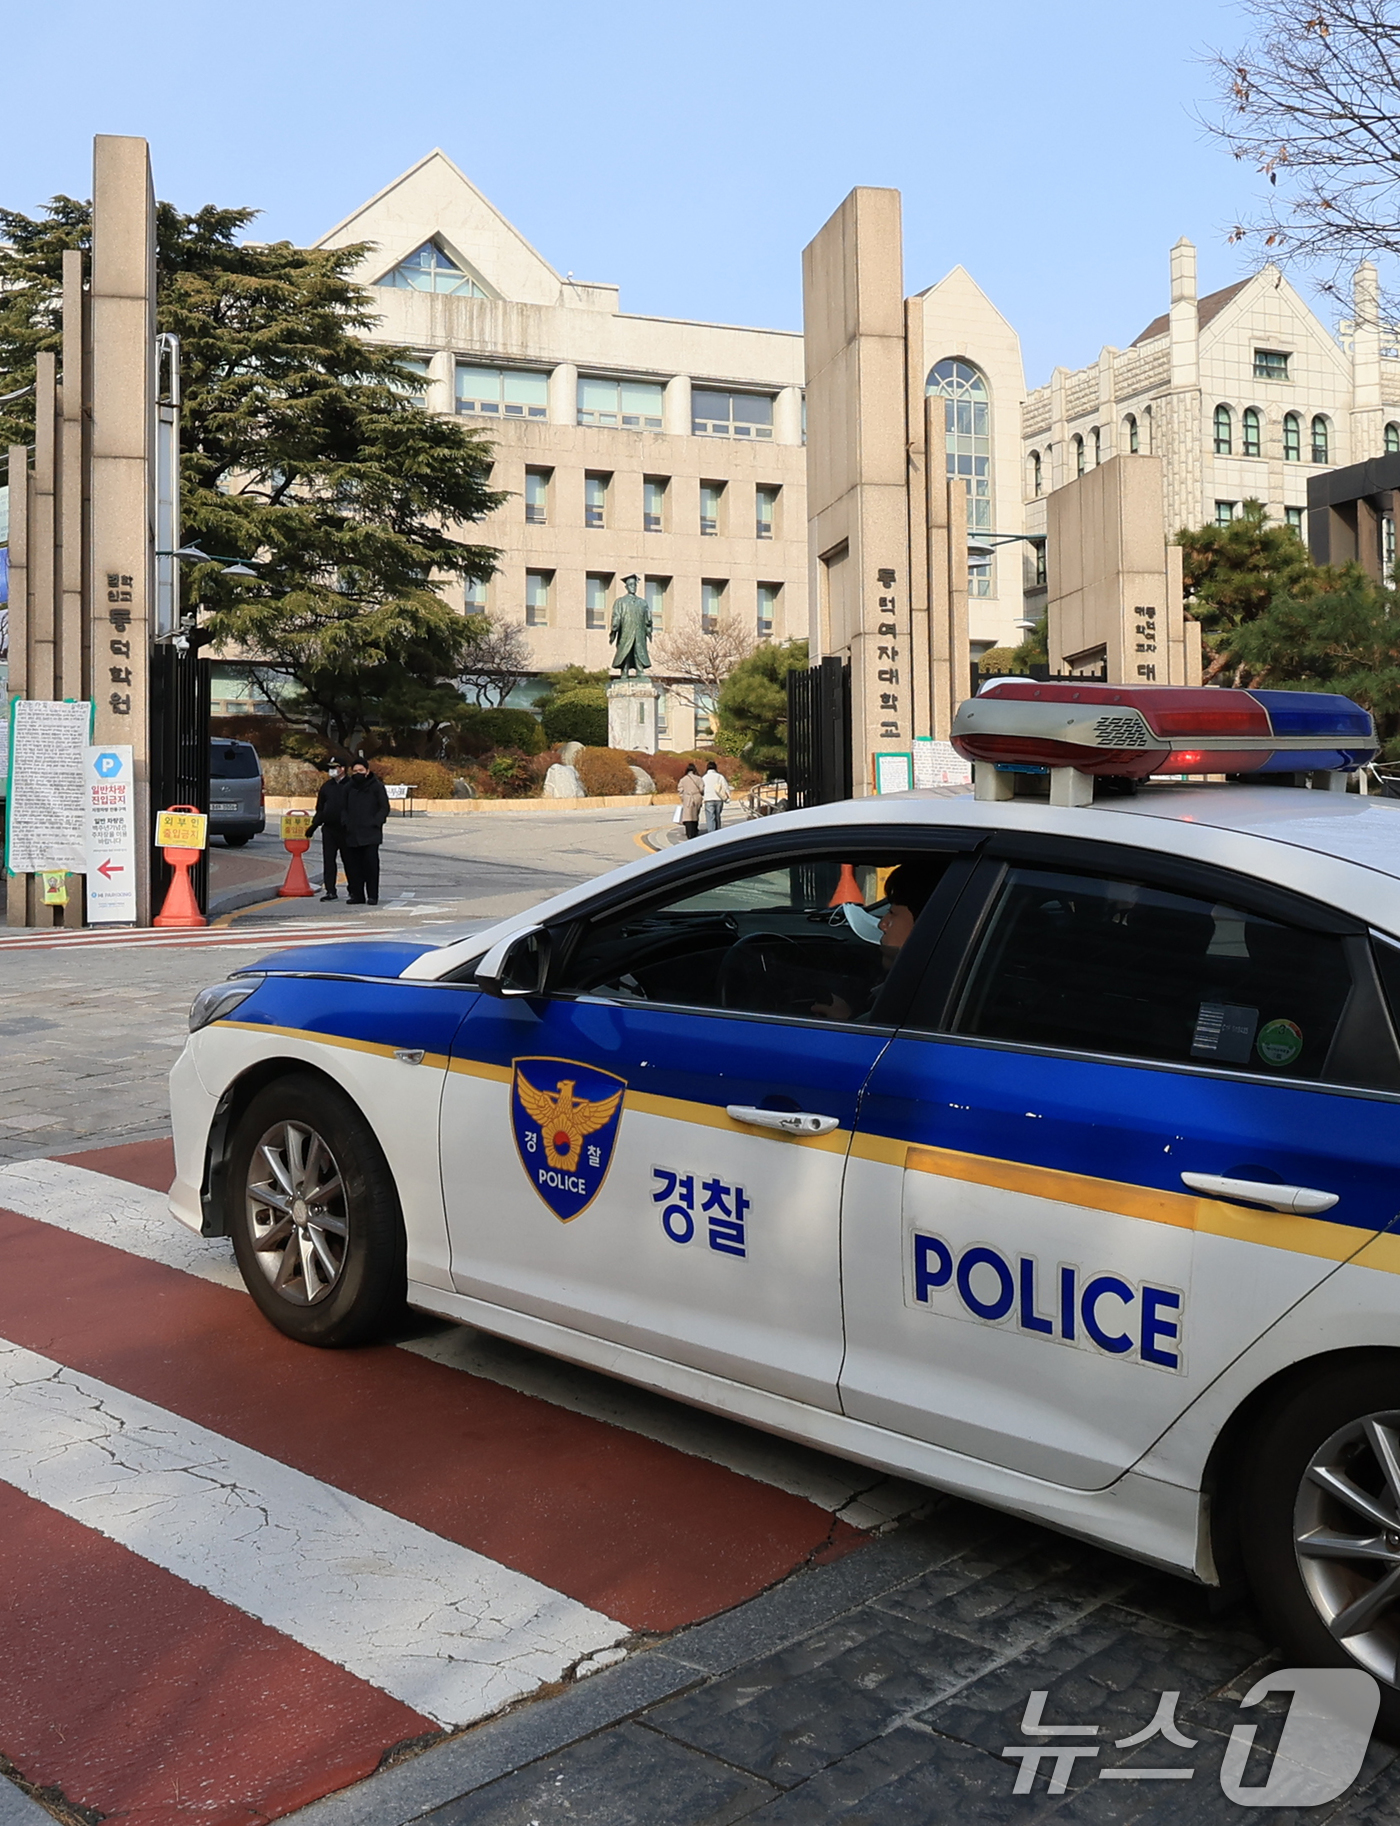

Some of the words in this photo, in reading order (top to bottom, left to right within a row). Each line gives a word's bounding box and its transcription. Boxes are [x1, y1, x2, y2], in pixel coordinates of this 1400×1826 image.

[108, 608, 133, 715] 동덕학원
[877, 568, 901, 738] 동덕여자대학교
[1136, 664, 1156, 682] 대
[91, 785, 126, 795] 일반차량
[91, 795, 126, 806] 진입금지
[163, 829, 199, 840] 출입금지
[538, 1169, 586, 1195] POLICE
[652, 1168, 751, 1258] 경찰
[914, 1233, 1180, 1369] POLICE
